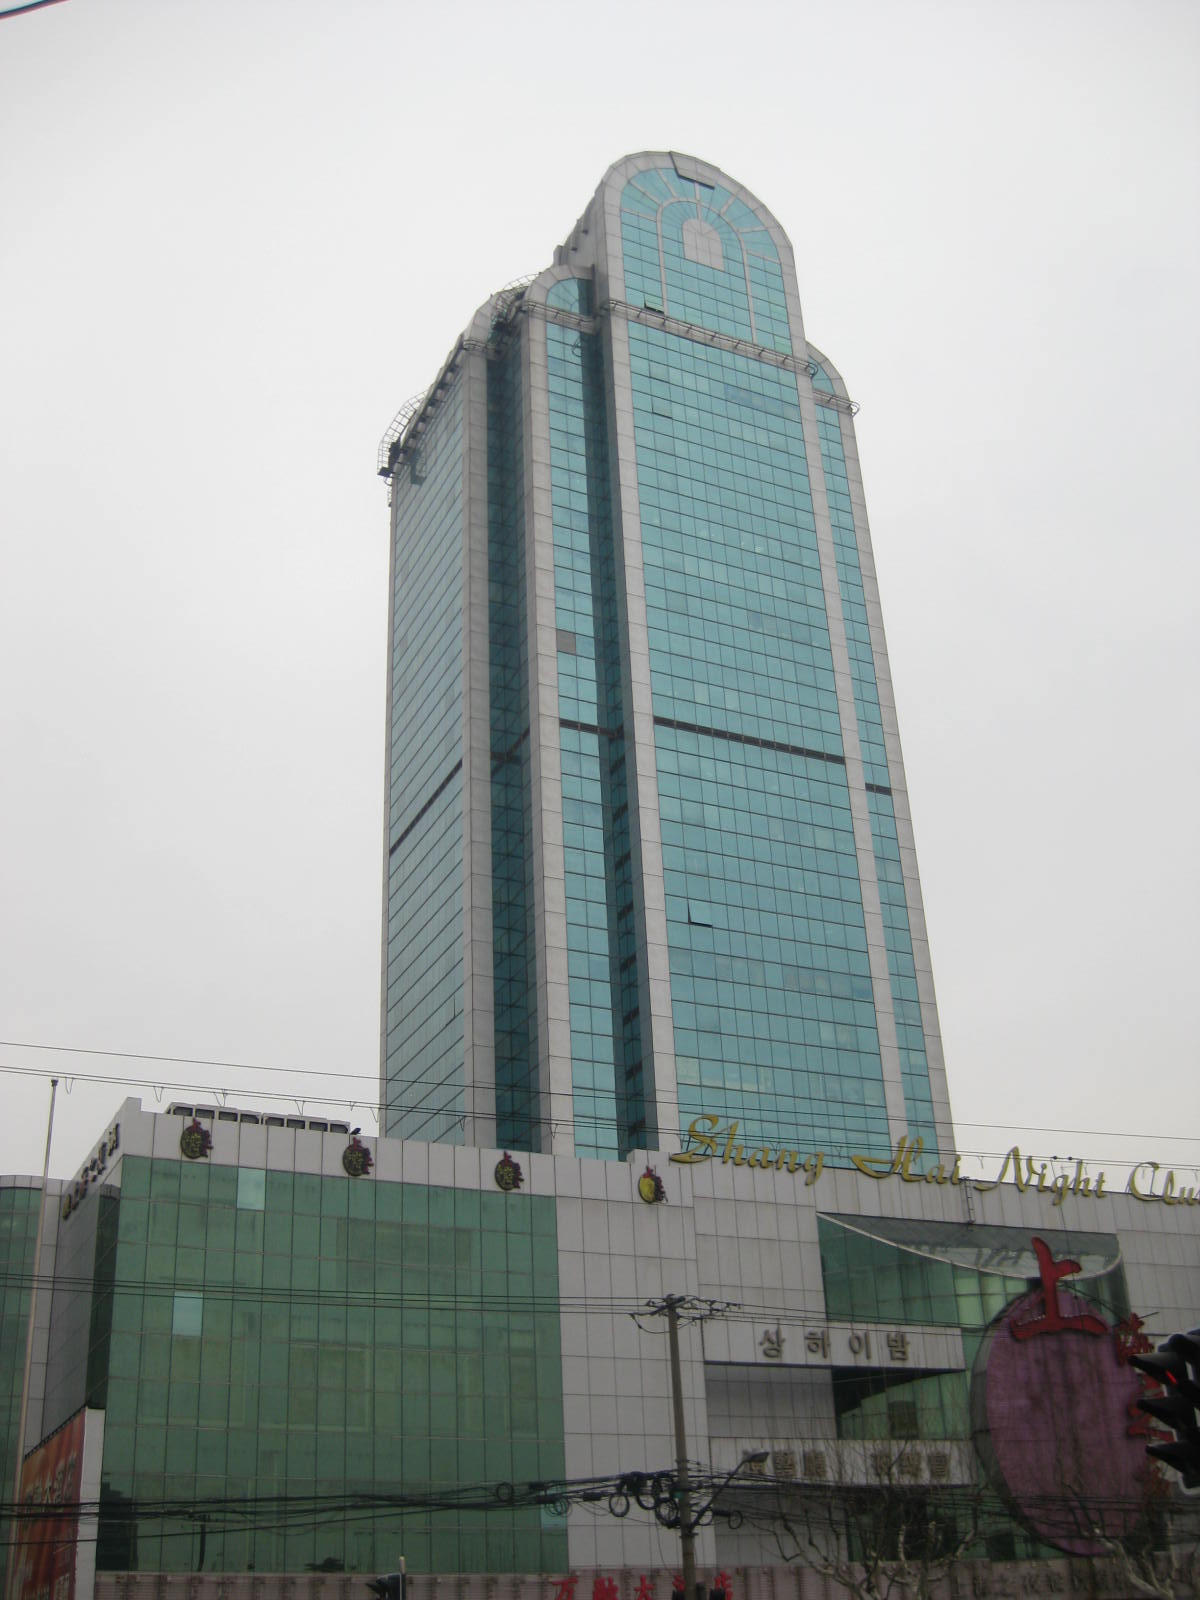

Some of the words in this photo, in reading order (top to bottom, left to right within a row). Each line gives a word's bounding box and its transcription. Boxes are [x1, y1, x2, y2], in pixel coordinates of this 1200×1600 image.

[669, 1114, 824, 1186] Shang
[851, 1135, 961, 1185] Hai
[973, 1146, 1106, 1206] Night
[1127, 1161, 1200, 1206] Clu
